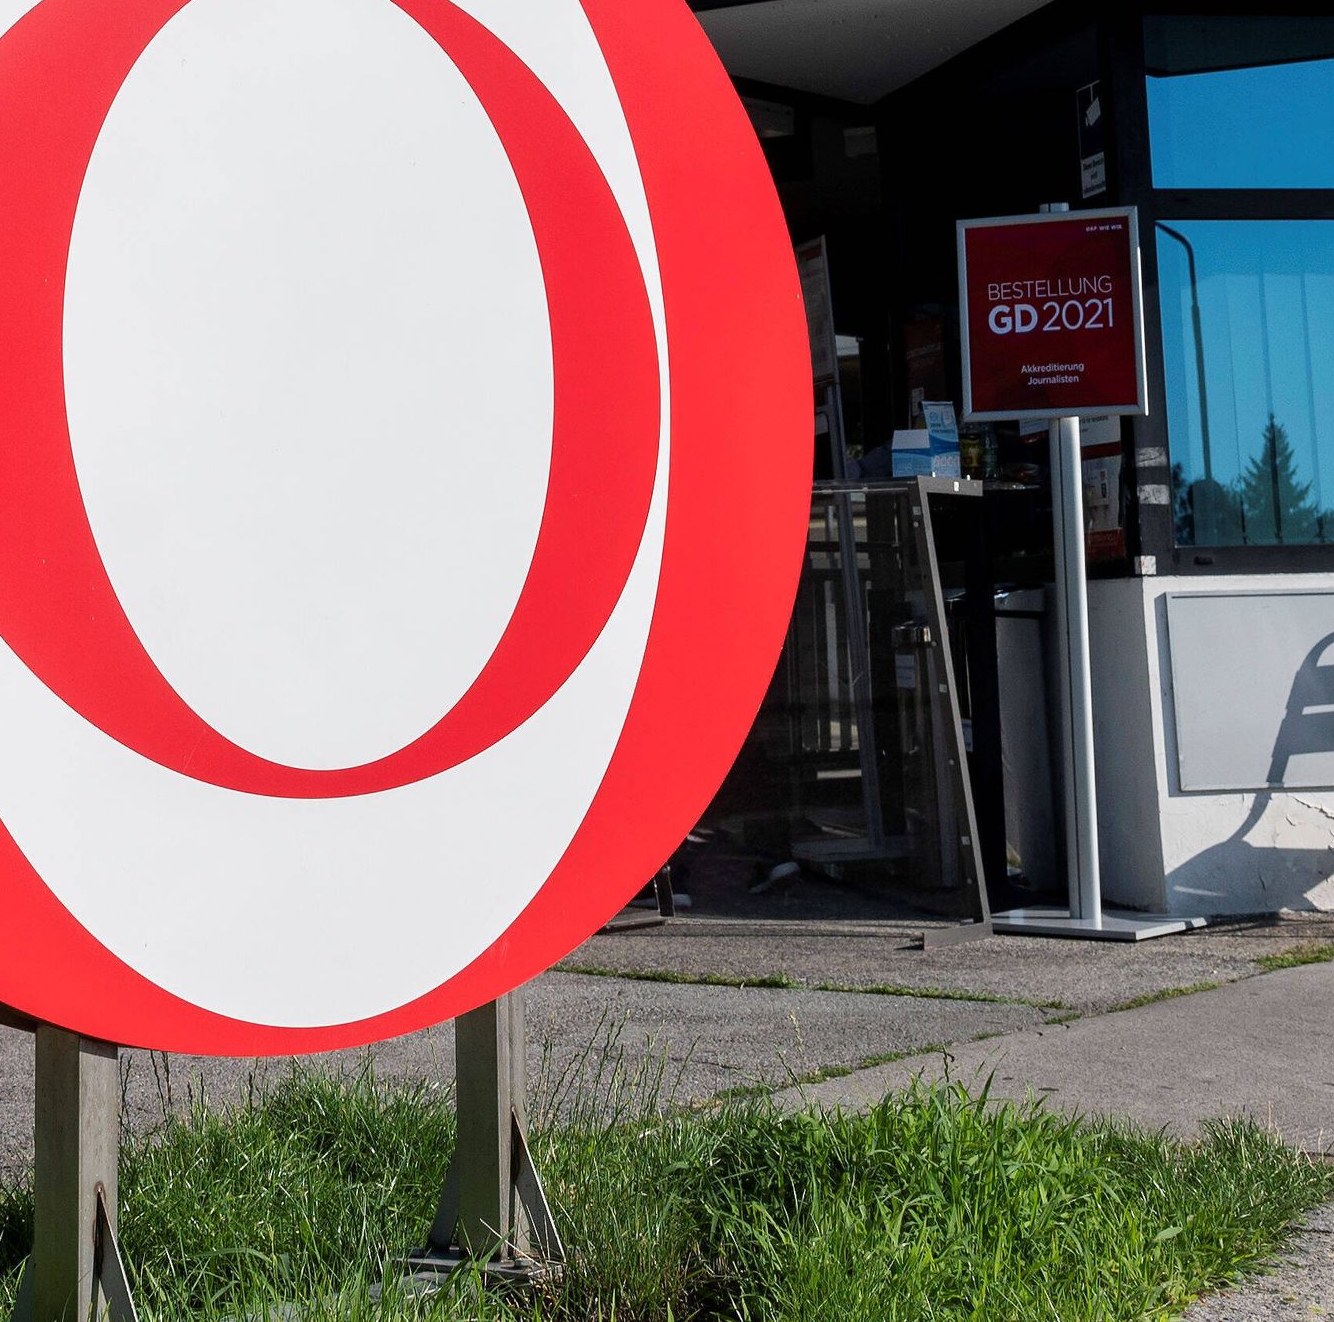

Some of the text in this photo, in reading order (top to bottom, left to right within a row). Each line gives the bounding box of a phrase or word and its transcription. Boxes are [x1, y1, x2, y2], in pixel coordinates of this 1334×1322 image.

[987, 275, 1113, 302] BESTELLUNG
[987, 297, 1115, 335] GD 2021
[1020, 361, 1086, 375] Akkreditierung
[1027, 374, 1080, 386] Journalisten
